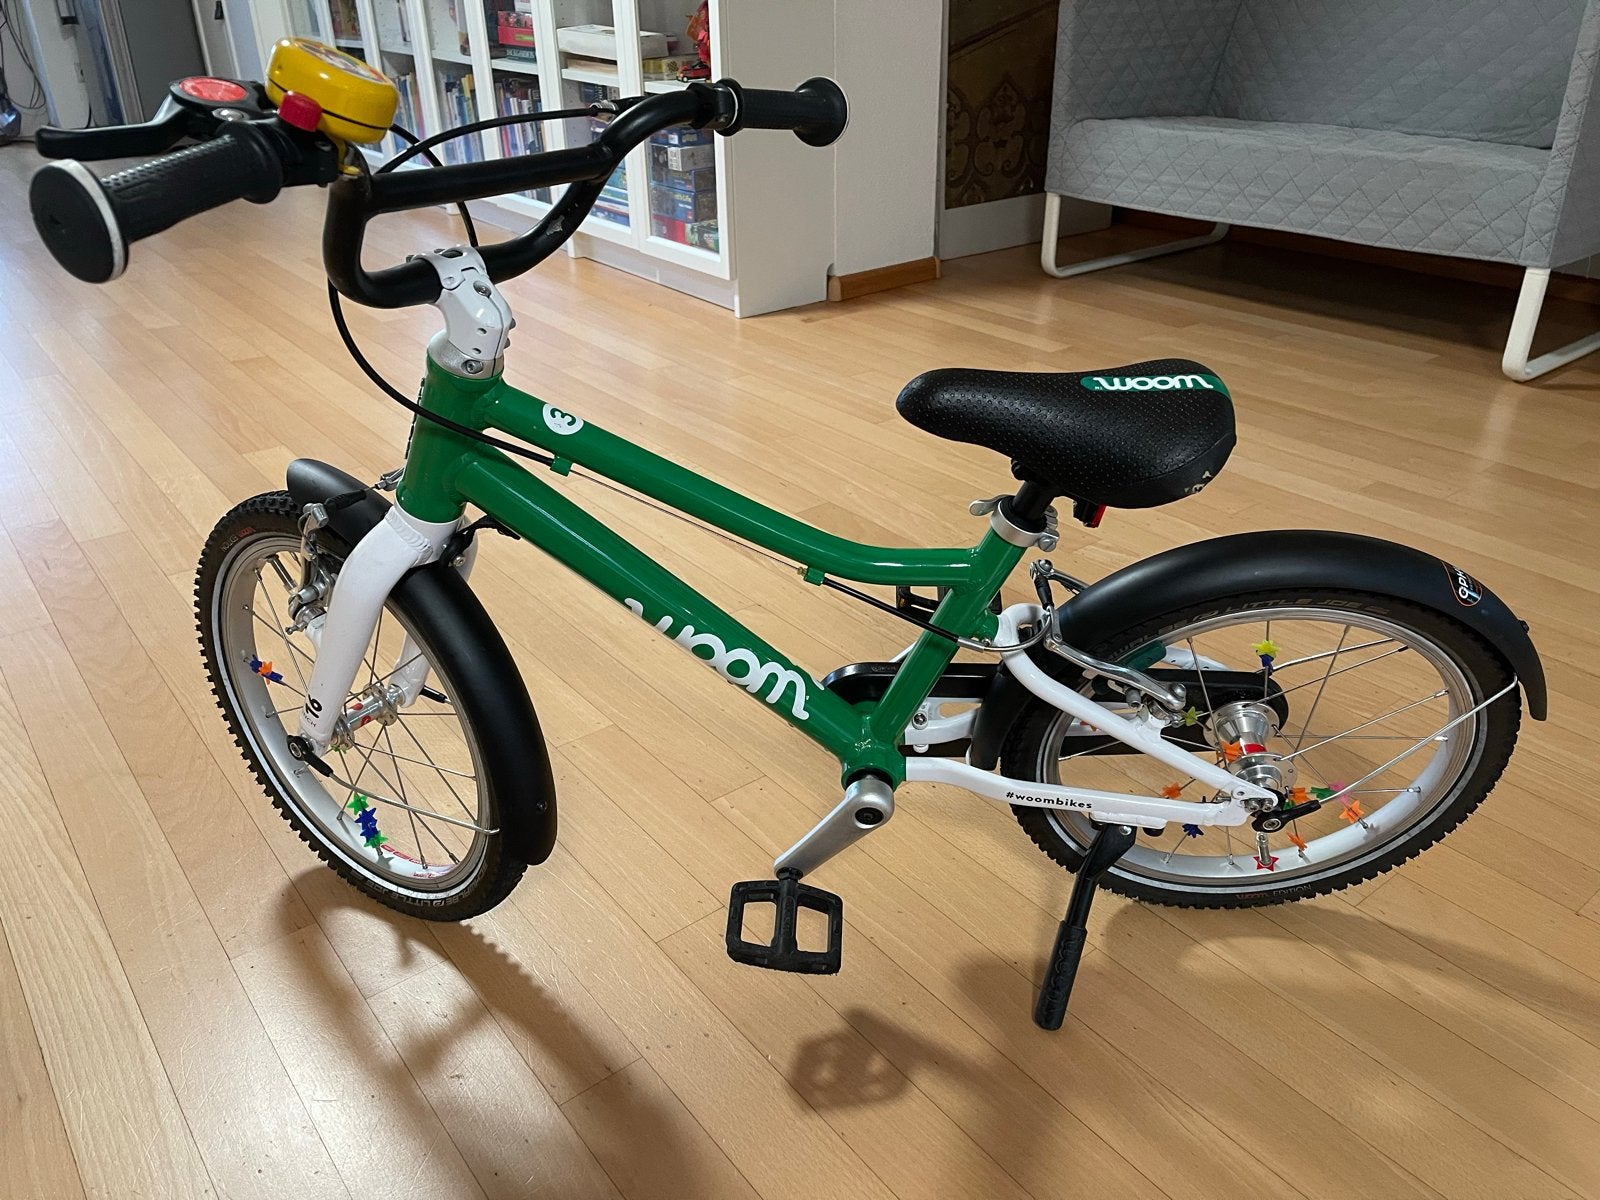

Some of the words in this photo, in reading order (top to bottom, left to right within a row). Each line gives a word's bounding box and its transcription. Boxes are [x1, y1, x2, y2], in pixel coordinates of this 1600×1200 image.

[1093, 374, 1214, 391] woom
[550, 407, 577, 427] 3
[305, 694, 322, 718] 16
[1006, 791, 1092, 809] #woombikes
